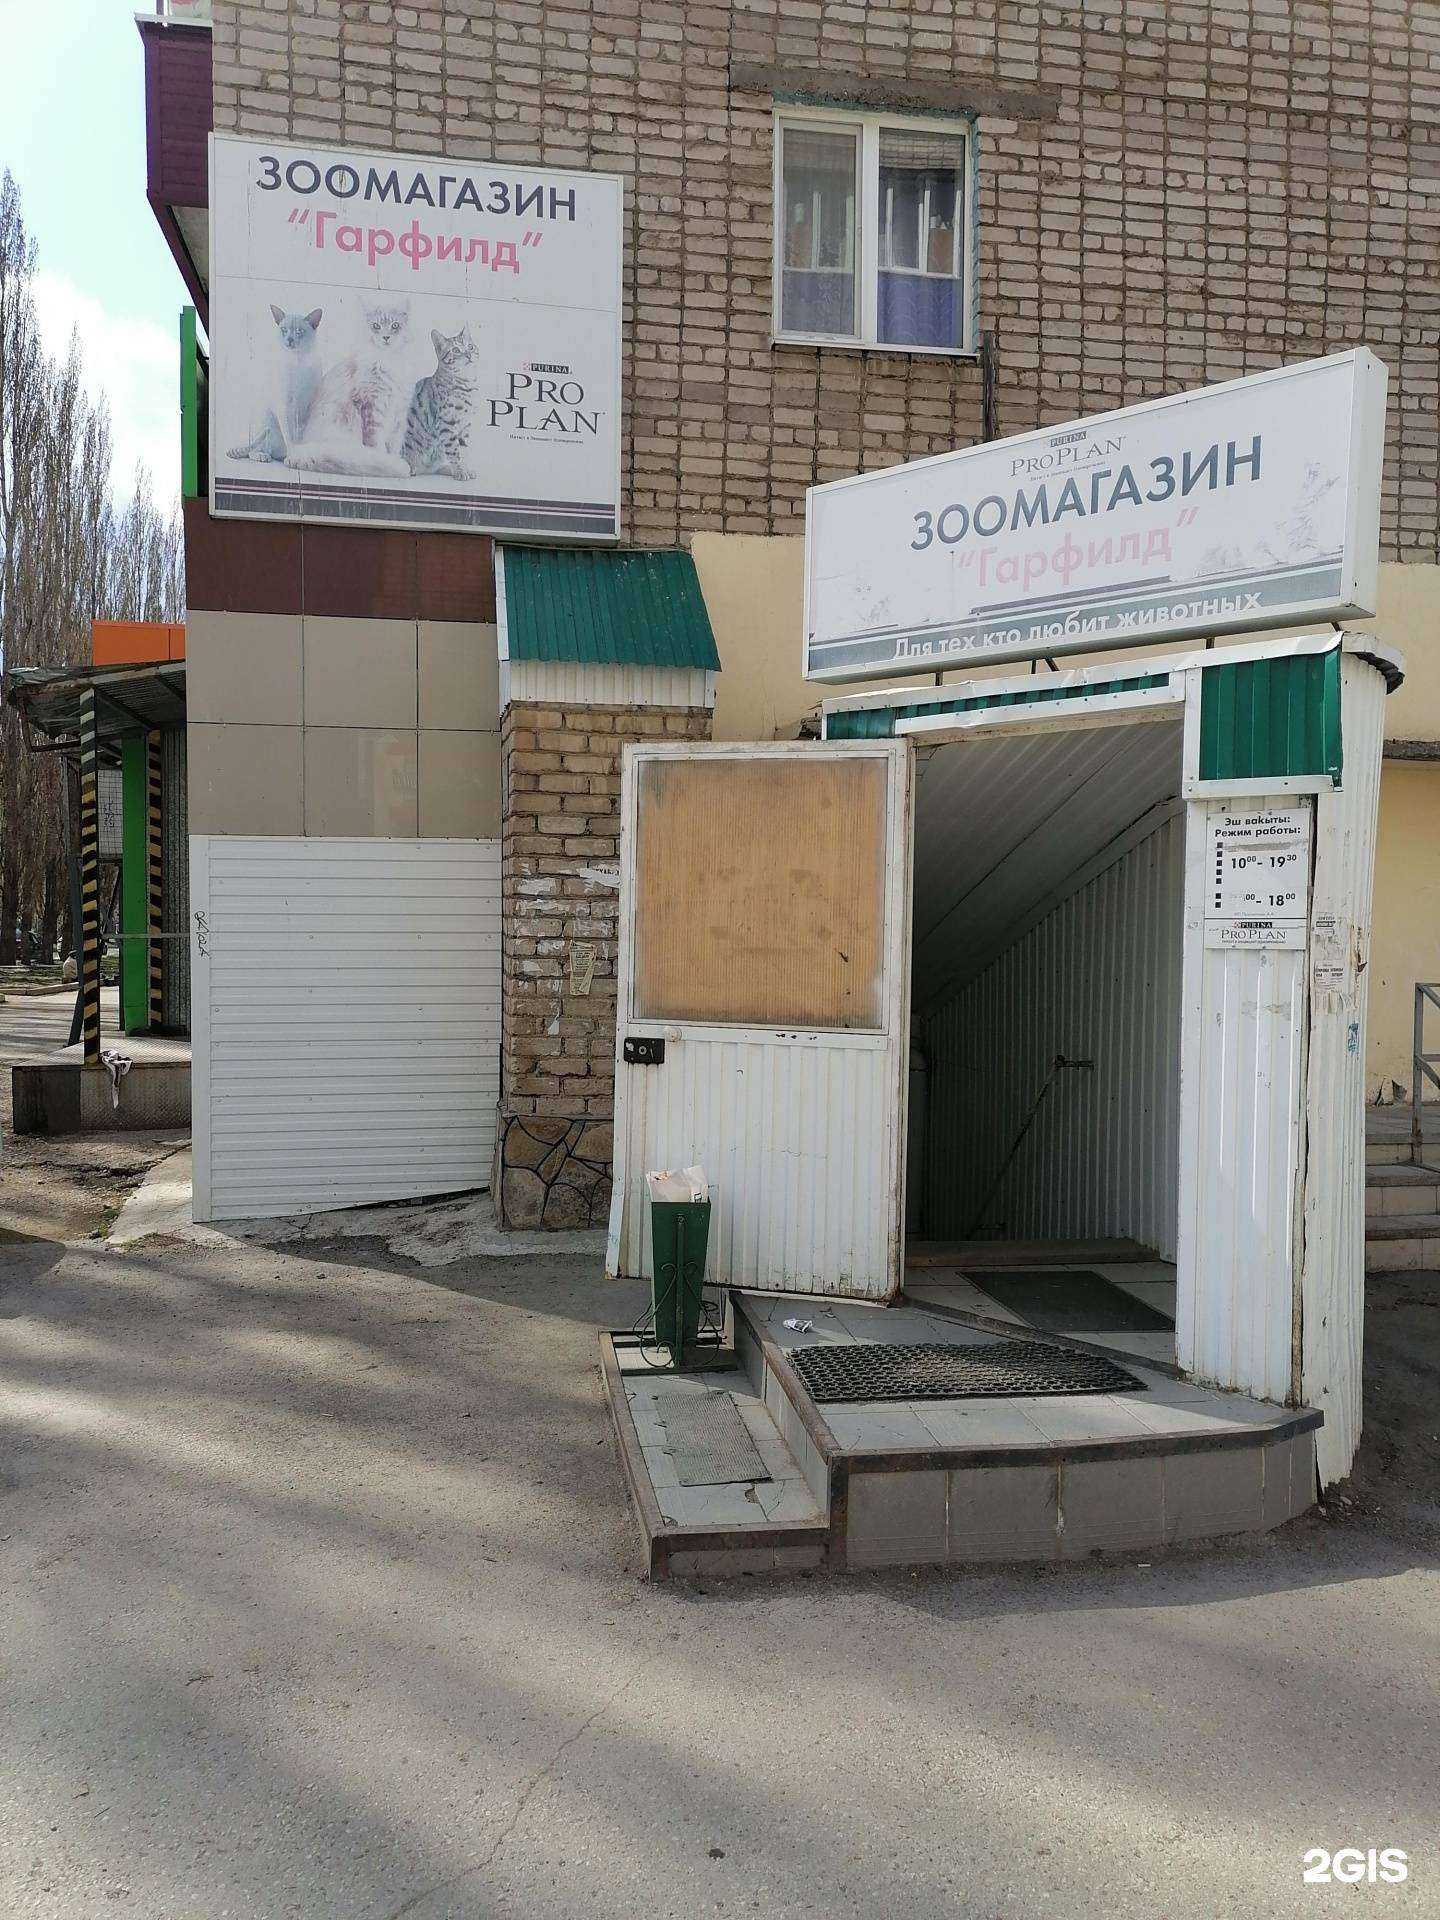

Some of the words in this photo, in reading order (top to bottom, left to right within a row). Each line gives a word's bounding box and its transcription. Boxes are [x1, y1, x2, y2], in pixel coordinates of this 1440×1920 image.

[255, 155, 577, 222] ЗООМАГАЗИН
[531, 363, 570, 375] PURINA
[505, 371, 585, 406] PRO
[486, 398, 602, 436] PLAN
[910, 434, 1263, 552] ЗООМАГАЗИН
[937, 632, 976, 656] тех
[982, 626, 1022, 649] кто
[1029, 609, 1111, 641] любит
[1116, 590, 1264, 627] животных
[1214, 829, 1252, 838] Режим
[1255, 826, 1301, 838] работы:
[1224, 817, 1241, 826] Эш
